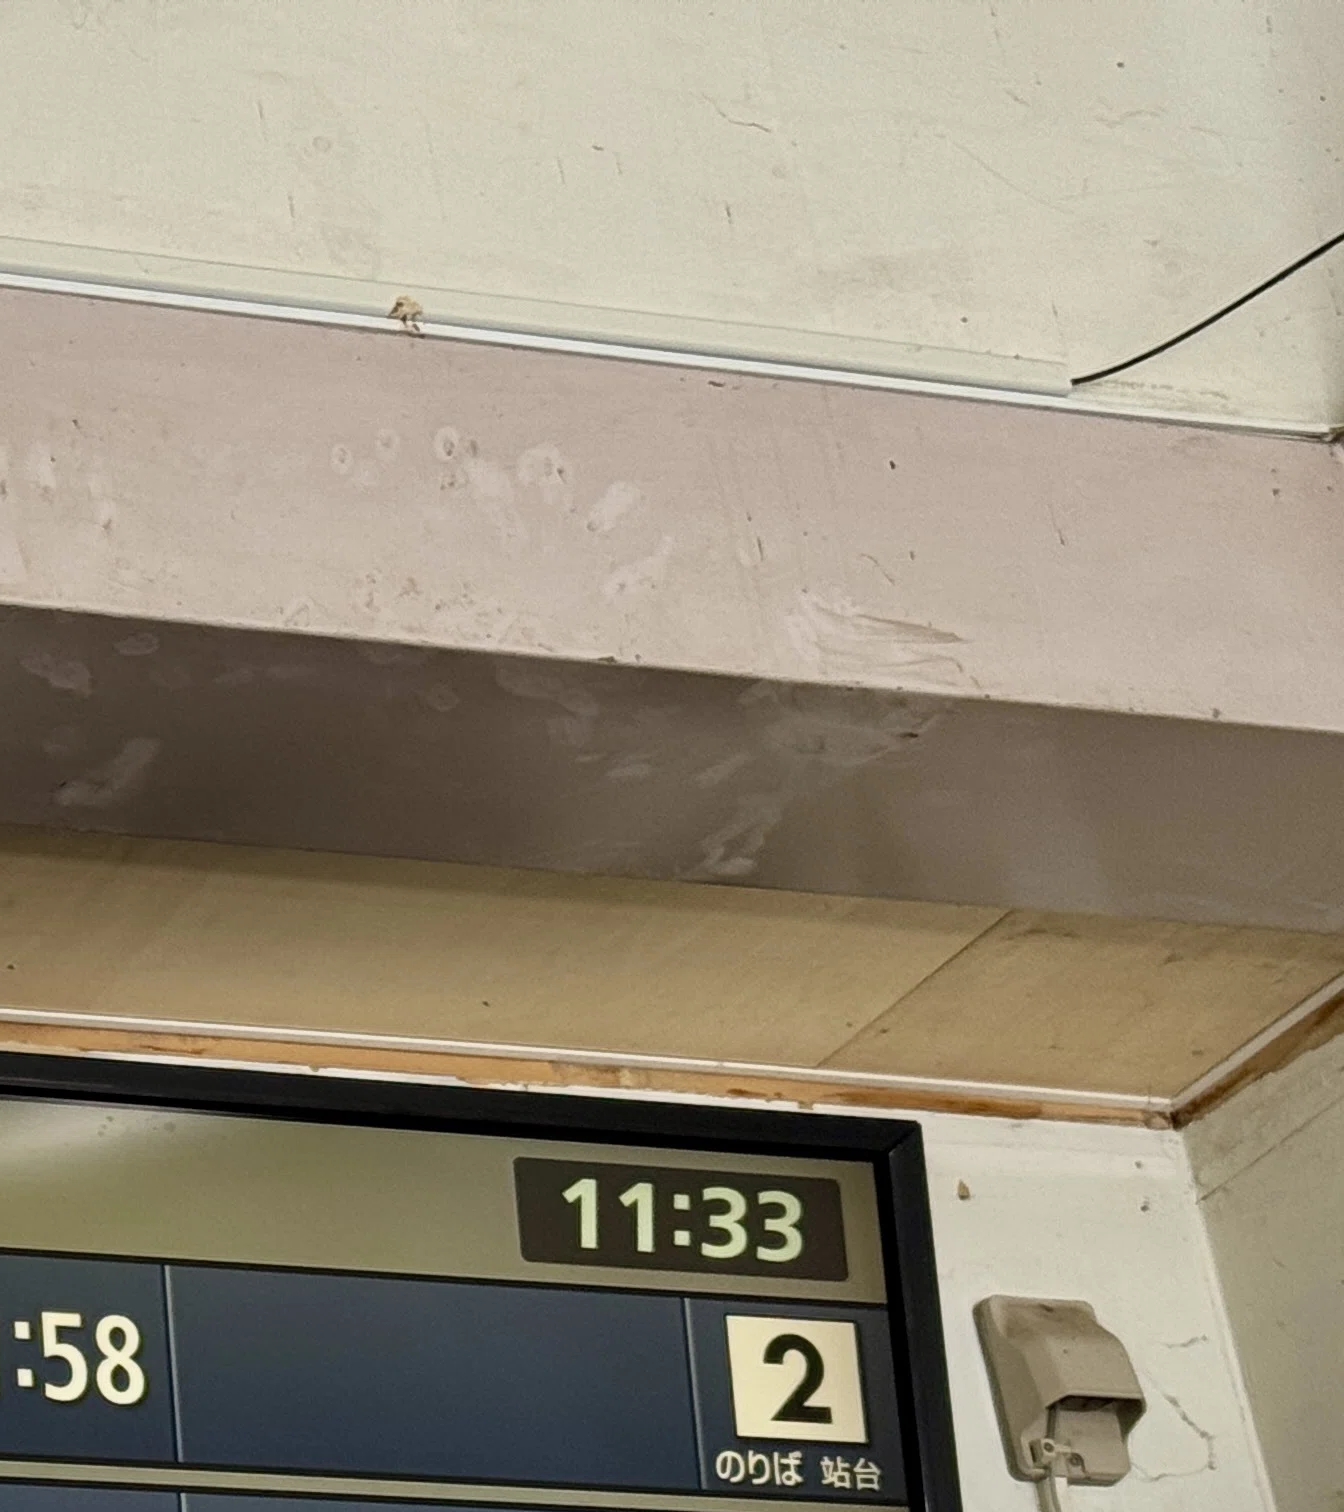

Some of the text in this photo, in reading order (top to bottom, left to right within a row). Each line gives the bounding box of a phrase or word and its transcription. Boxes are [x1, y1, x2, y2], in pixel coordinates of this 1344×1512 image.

[562, 1177, 803, 1264] 11:33
[763, 1333, 833, 1425] 2
[715, 1449, 882, 1491] のりば 站台
